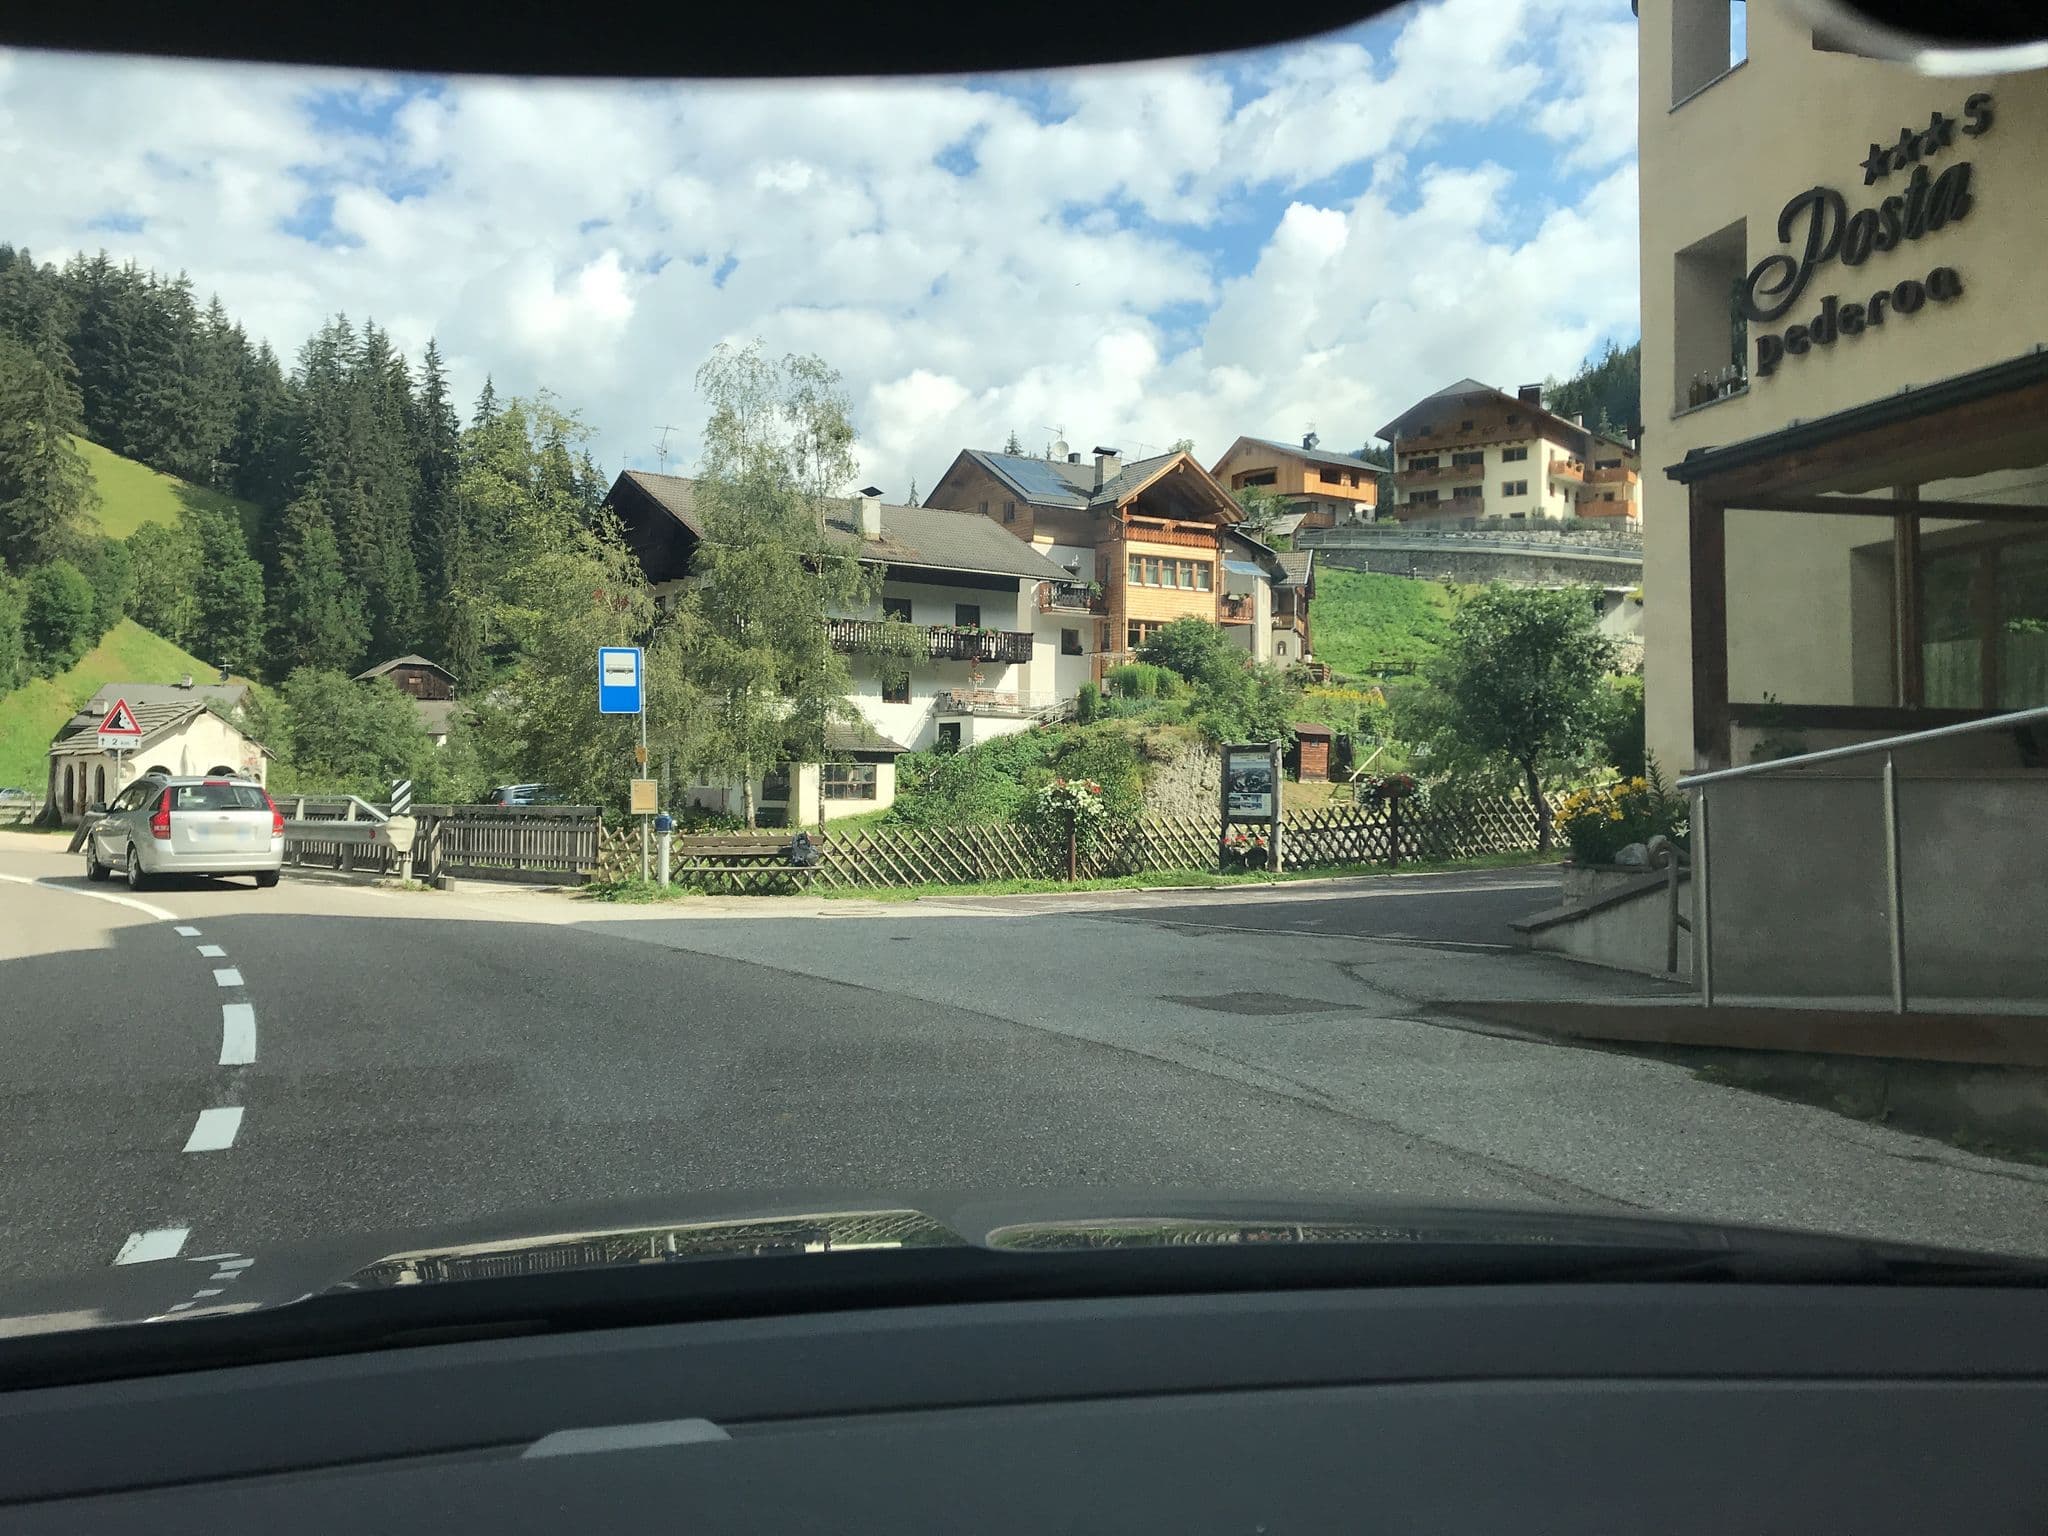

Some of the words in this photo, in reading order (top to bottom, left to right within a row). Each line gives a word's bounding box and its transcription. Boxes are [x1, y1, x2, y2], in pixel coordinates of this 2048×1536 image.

[1745, 161, 1975, 322] Posta
[1755, 266, 1965, 377] pederoa
[112, 737, 118, 745] 2
